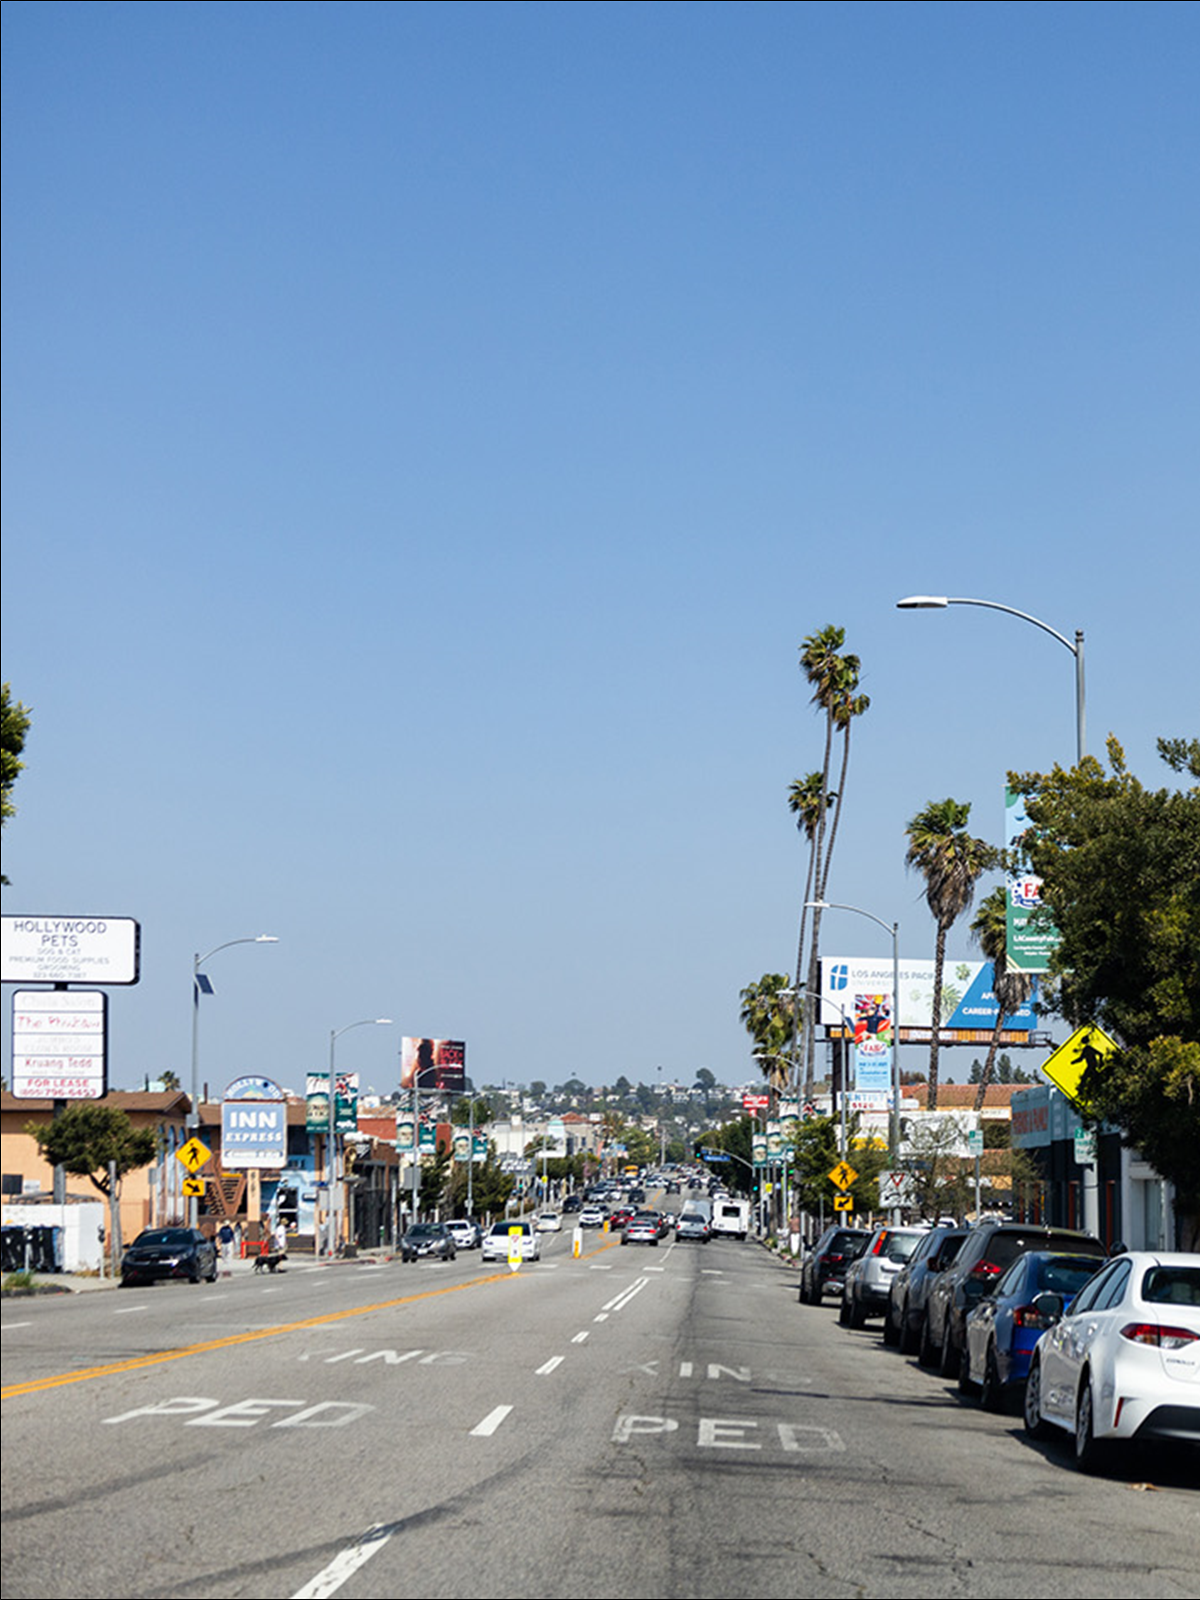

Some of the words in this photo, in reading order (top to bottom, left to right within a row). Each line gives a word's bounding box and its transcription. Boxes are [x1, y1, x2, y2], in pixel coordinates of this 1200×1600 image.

[14, 920, 108, 934] HOLLYWOOD
[41, 935, 79, 947] PETS
[852, 970, 869, 979] LOS
[870, 971, 910, 980] ANGEES
[27, 1078, 50, 1087] FOR
[53, 1079, 89, 1087] LEASE
[230, 1111, 277, 1129] INN
[225, 1132, 282, 1142] EXPRESS
[100, 1397, 376, 1428] PED
[610, 1414, 848, 1452] PED
